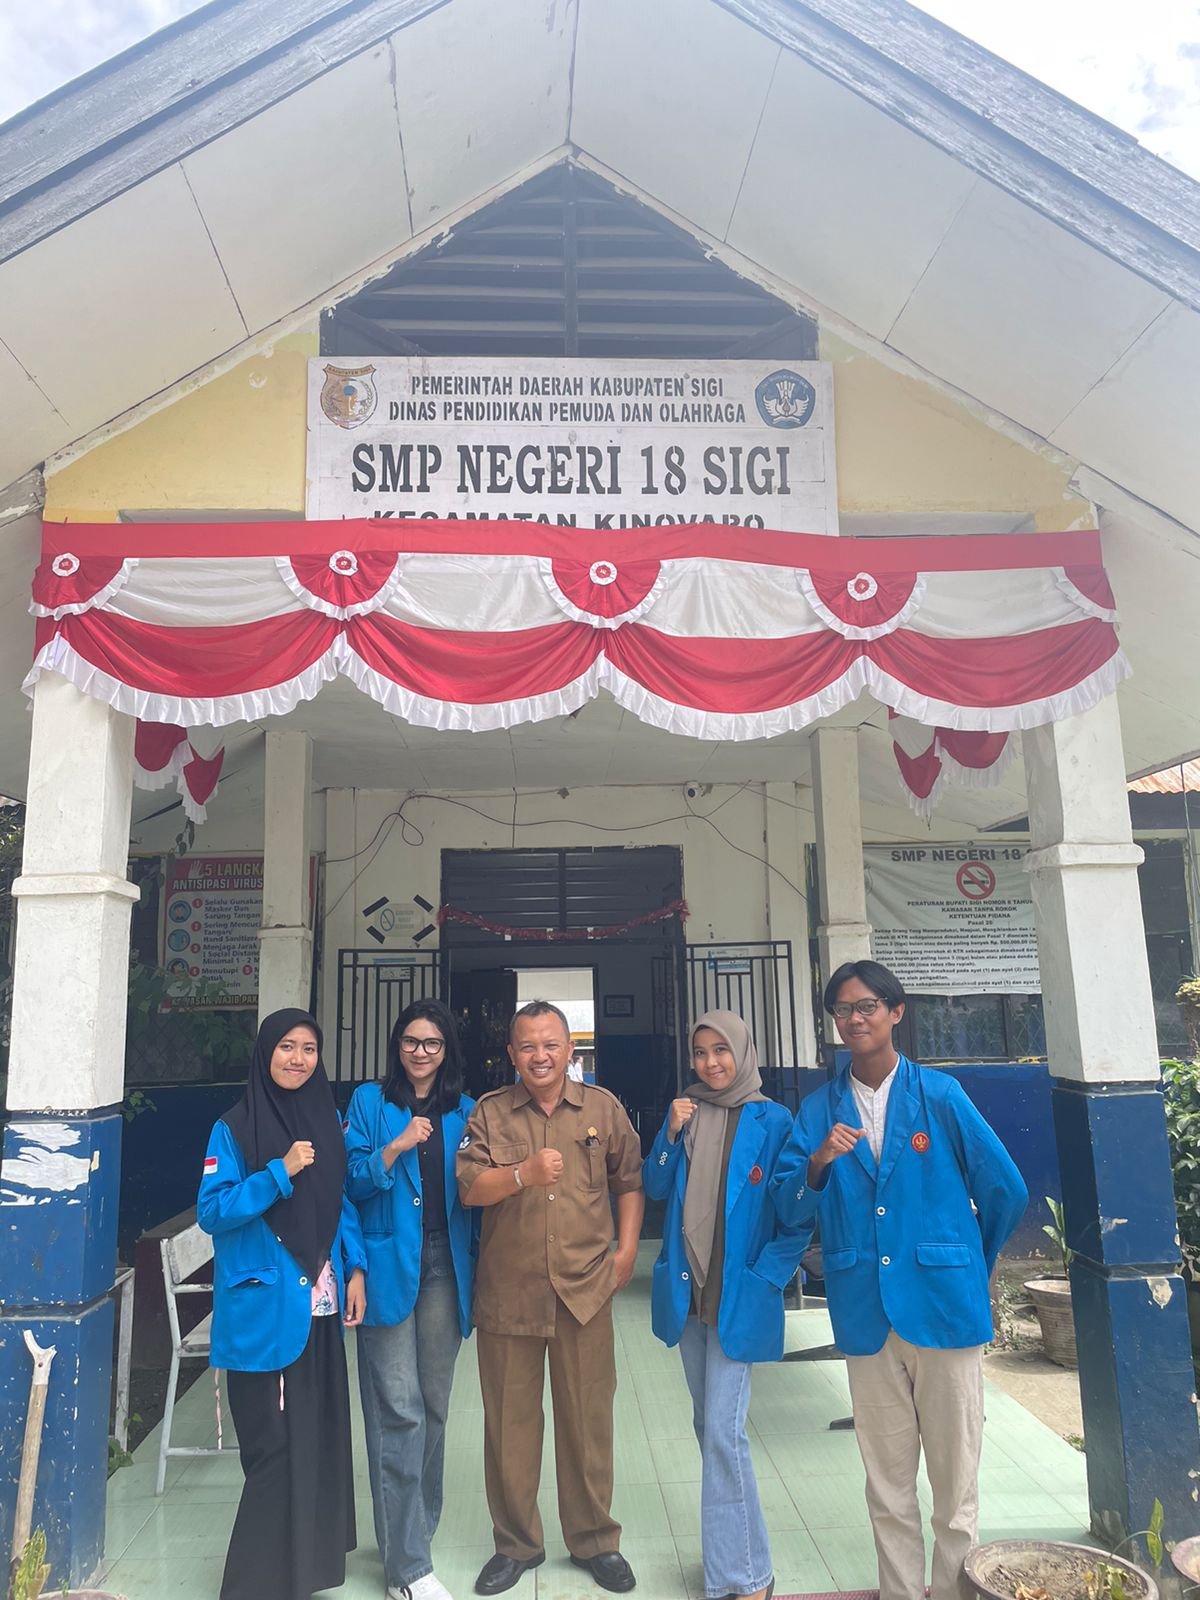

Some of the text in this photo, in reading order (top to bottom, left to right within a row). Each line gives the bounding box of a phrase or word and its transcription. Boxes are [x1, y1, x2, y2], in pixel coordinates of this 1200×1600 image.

[411, 375, 724, 397] PEMERINTAH DAERAH KABUPATEN SIGI
[389, 401, 746, 423] DINAS PENDIDIKAN PEMUDA DAN OLAHRAGA
[351, 443, 791, 495] SMP NEGERI 18 SIGI
[891, 850, 926, 862] SMP
[932, 849, 996, 862] NEGERI
[1001, 849, 1022, 860] 18
[204, 864, 213, 876] 5
[172, 878, 263, 890] ANTISIPASI VIRUS
